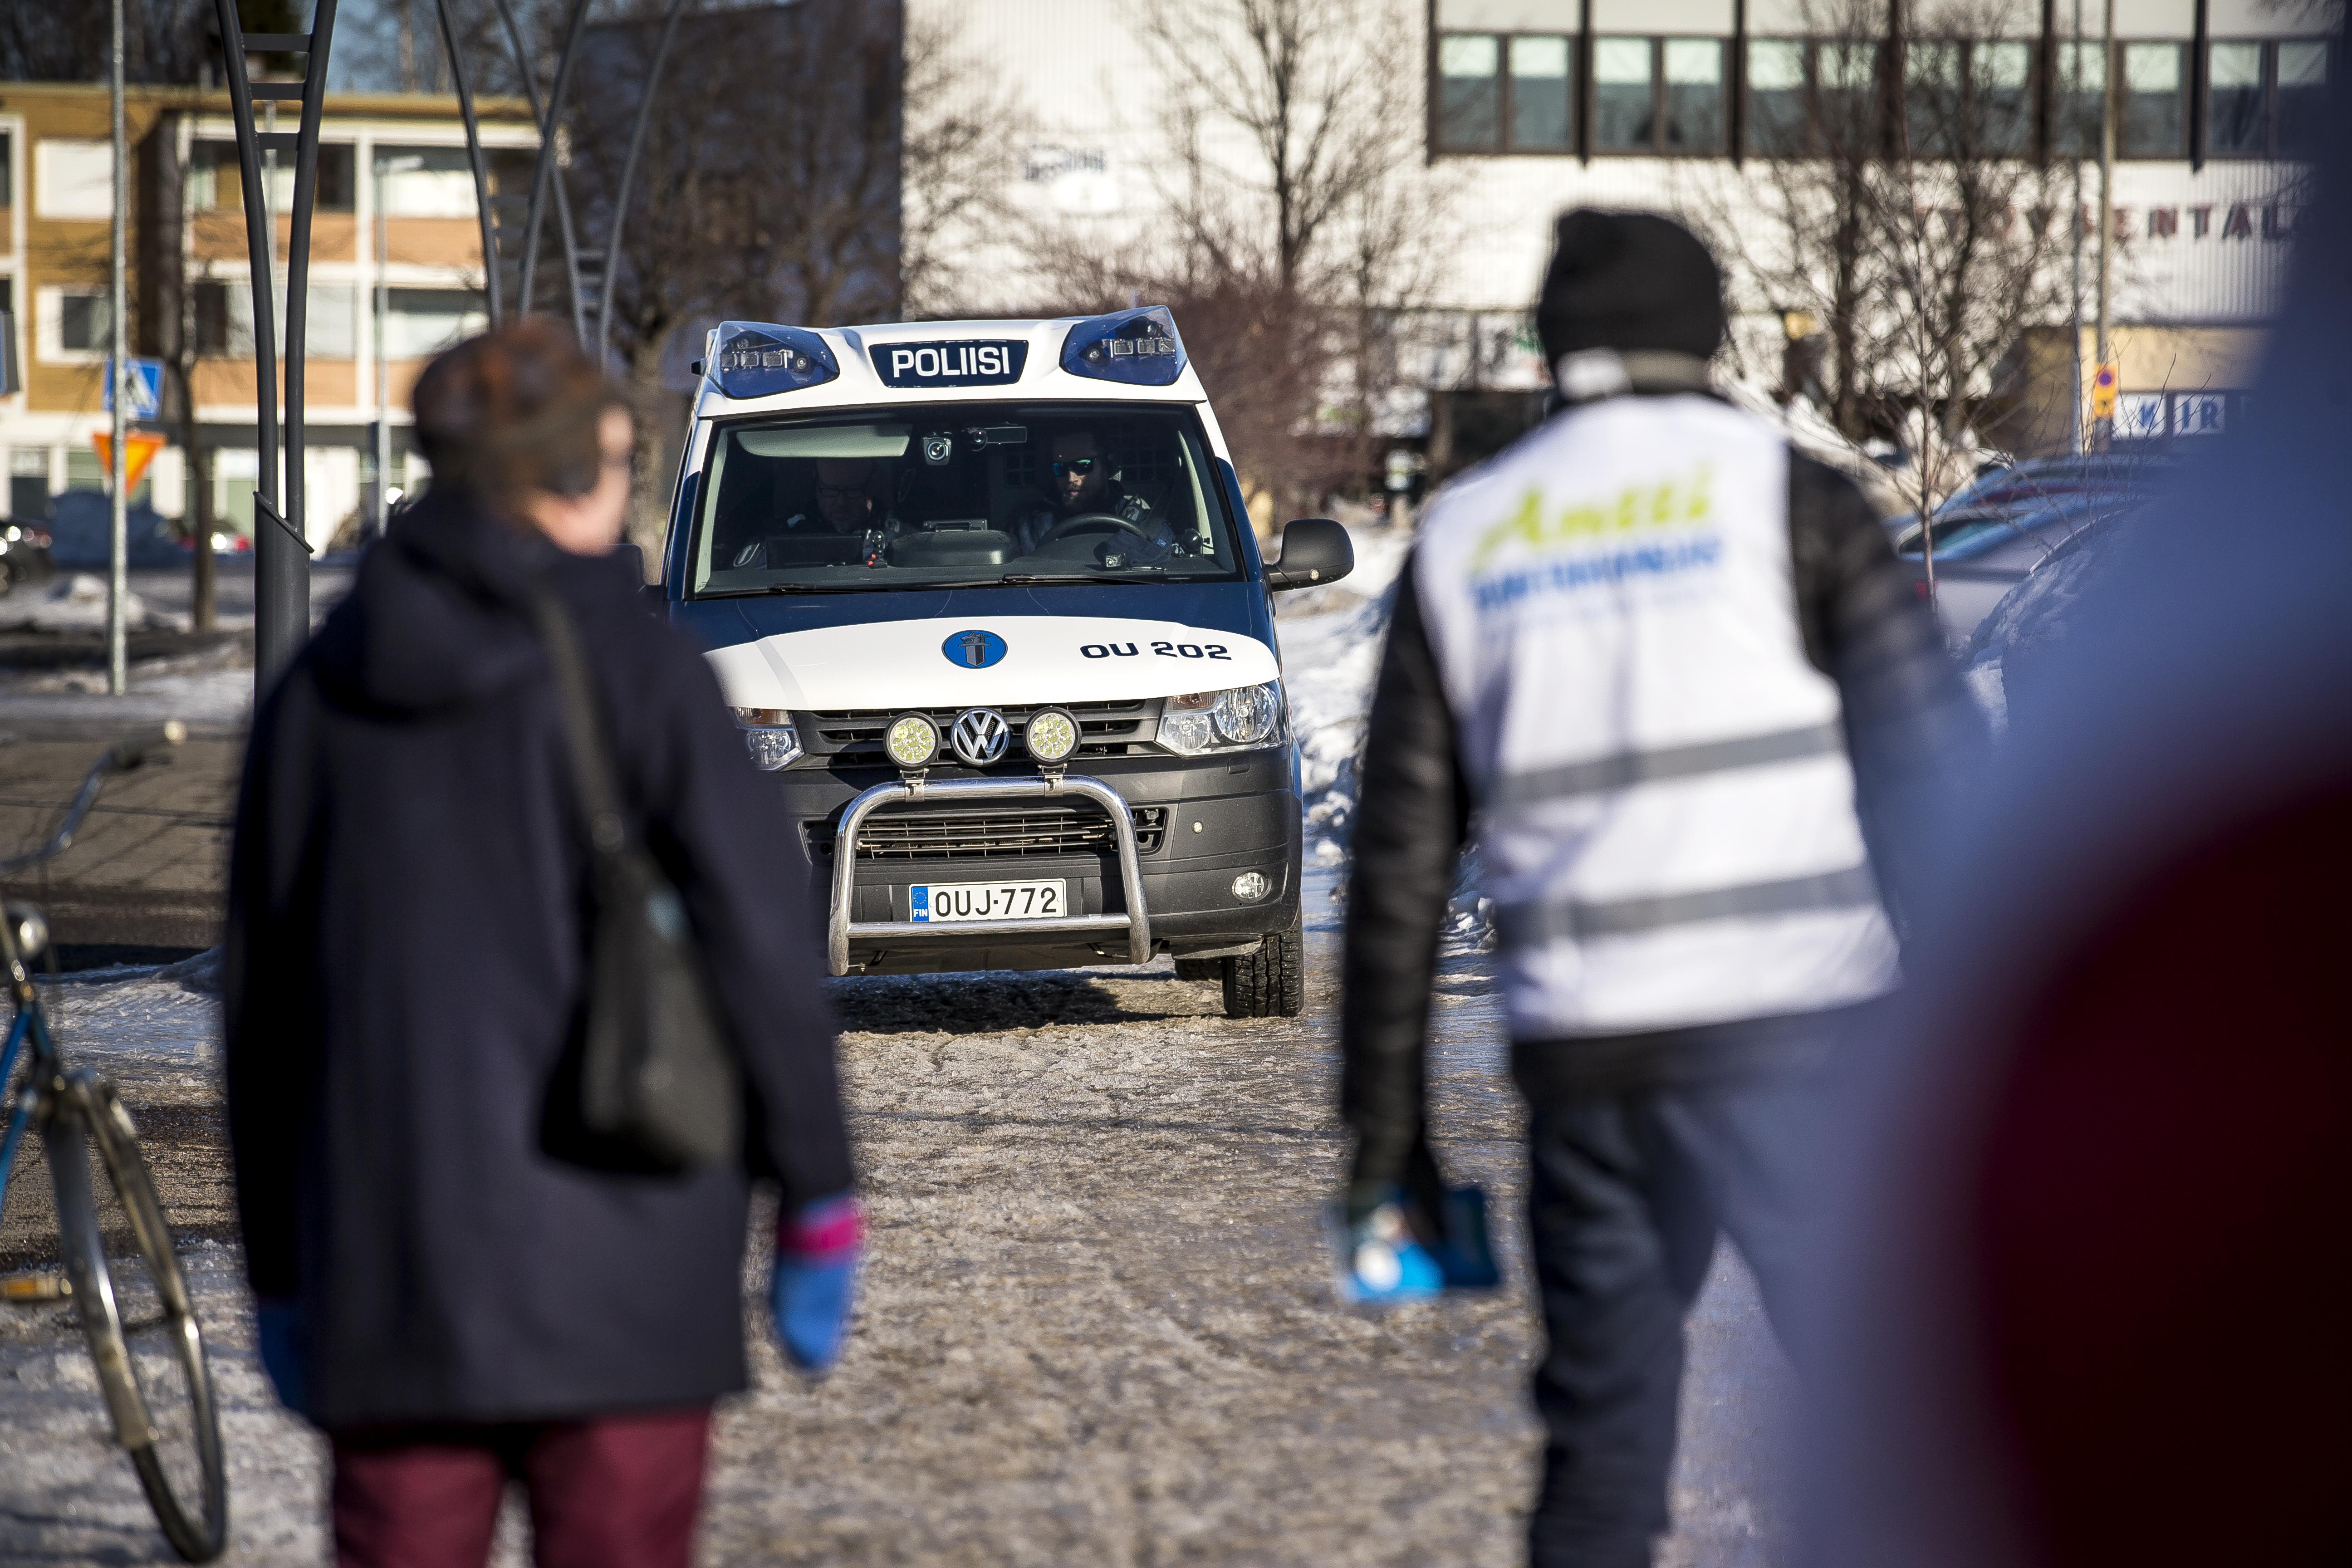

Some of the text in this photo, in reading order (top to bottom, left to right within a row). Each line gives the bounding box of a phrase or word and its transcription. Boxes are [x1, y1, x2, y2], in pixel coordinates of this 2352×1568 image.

[892, 347, 1010, 378] POLIISI
[1080, 642, 1232, 660] OU 202
[913, 909, 928, 917] FIN
[935, 887, 1057, 917] OUJ-772
